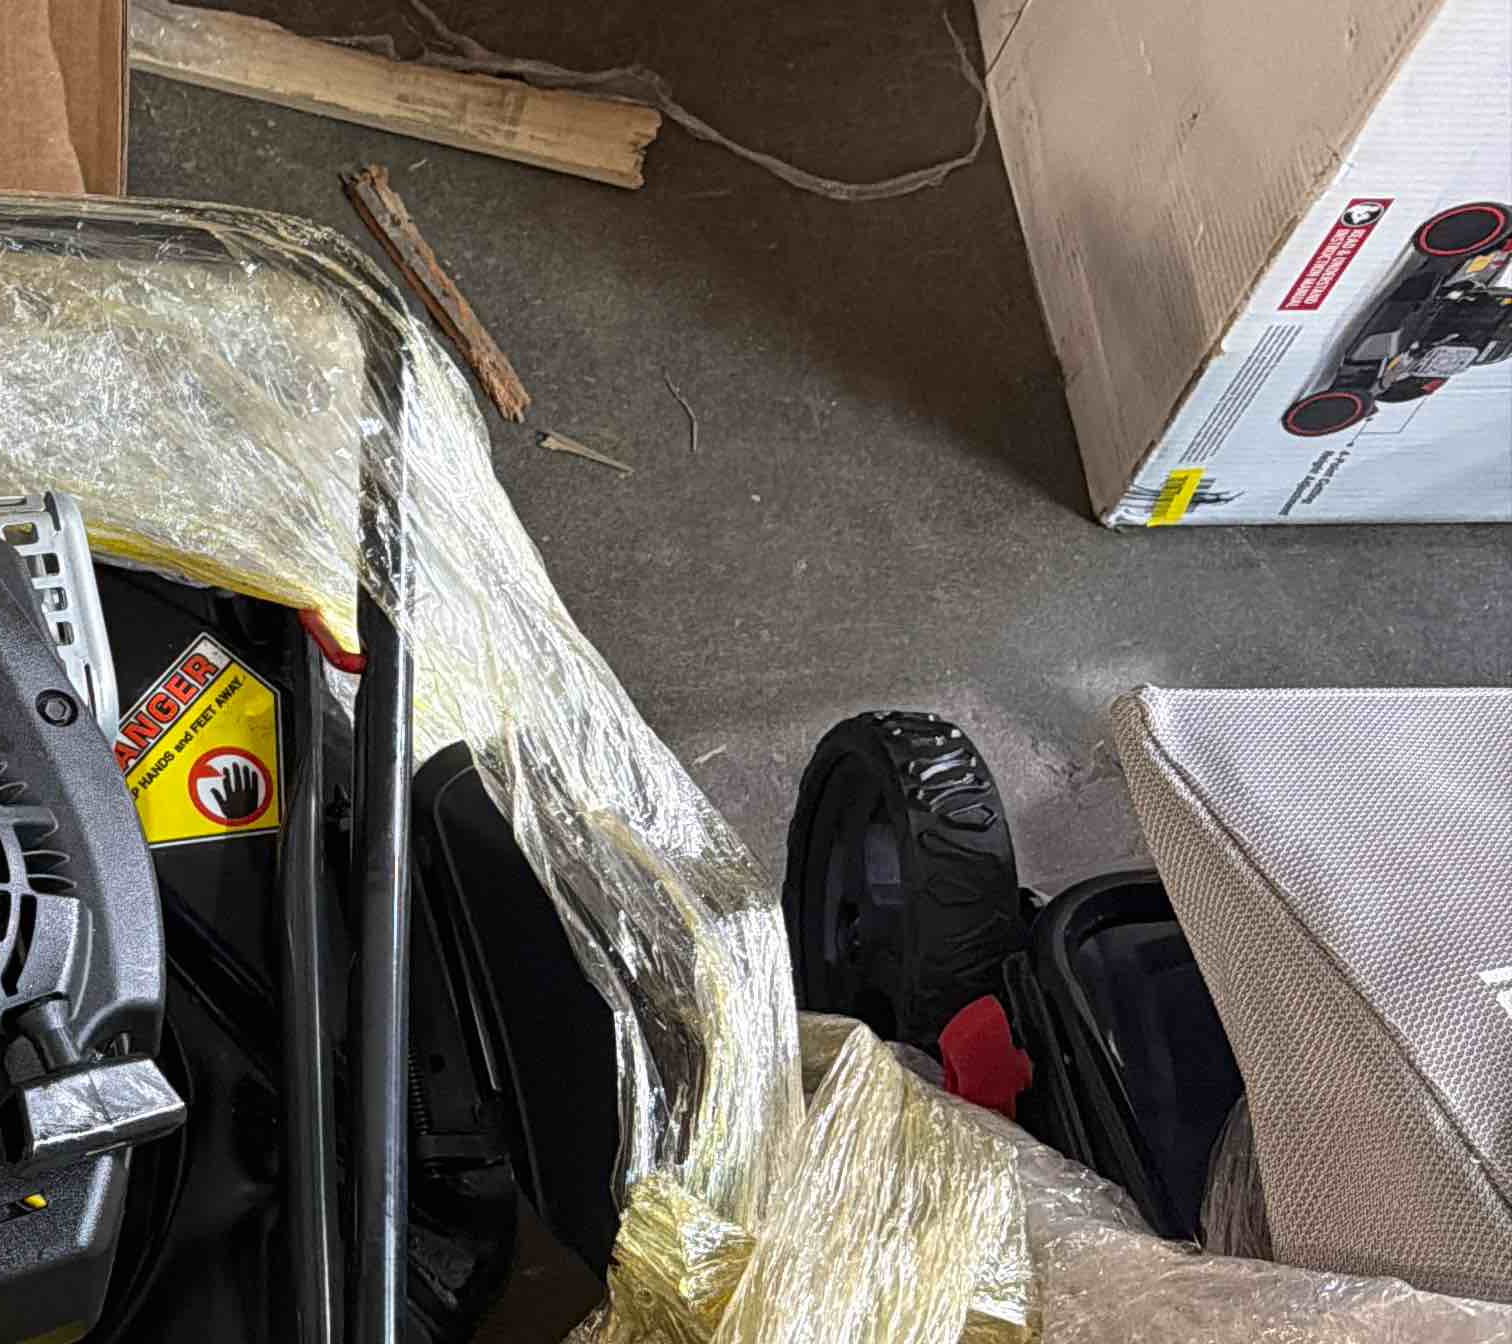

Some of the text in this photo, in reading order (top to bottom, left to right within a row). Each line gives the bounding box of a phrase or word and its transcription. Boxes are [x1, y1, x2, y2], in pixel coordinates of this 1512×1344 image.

[113, 652, 220, 774] ANGER
[138, 750, 175, 790] HANDS
[173, 729, 194, 753] and
[189, 703, 217, 735] FEET
